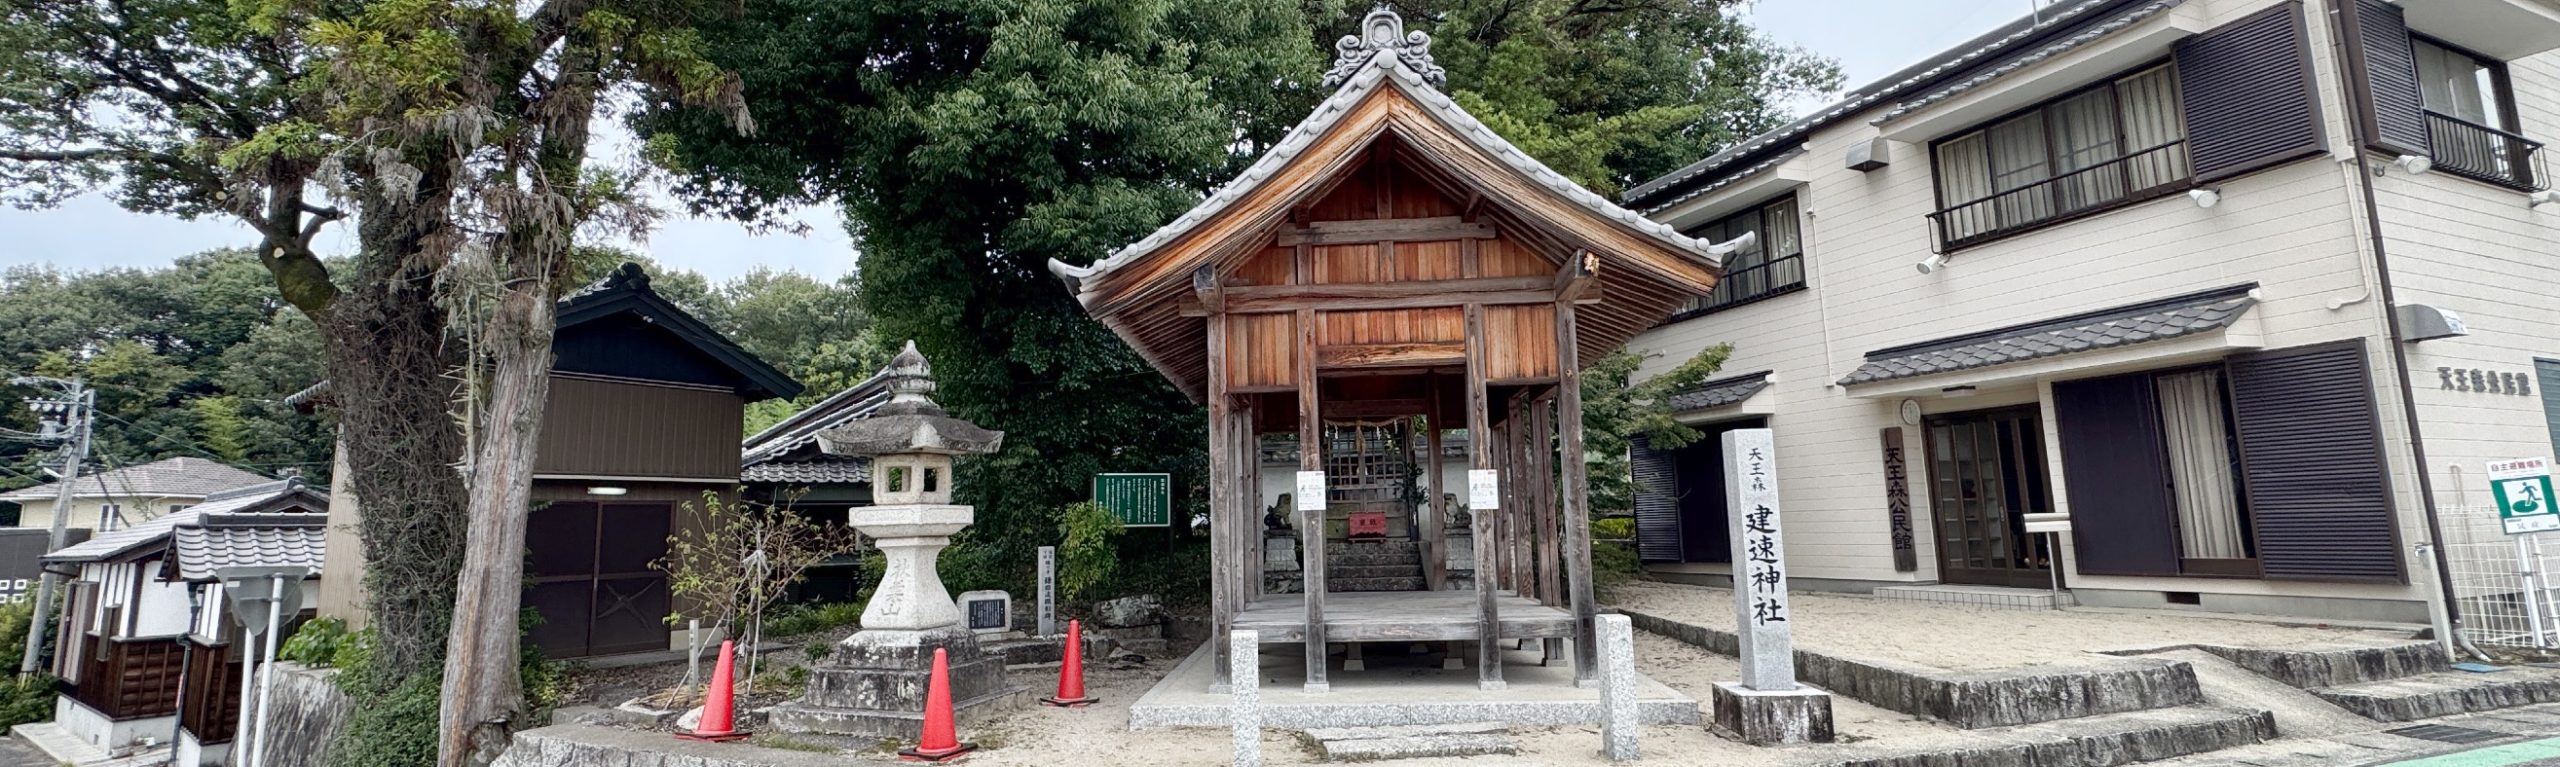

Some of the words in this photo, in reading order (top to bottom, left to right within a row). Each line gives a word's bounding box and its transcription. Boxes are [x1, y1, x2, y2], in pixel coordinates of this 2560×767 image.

[1749, 447, 1766, 492] 天王森
[1885, 447, 1912, 550] 天王森公民館
[1745, 504, 1786, 626] 建速神社
